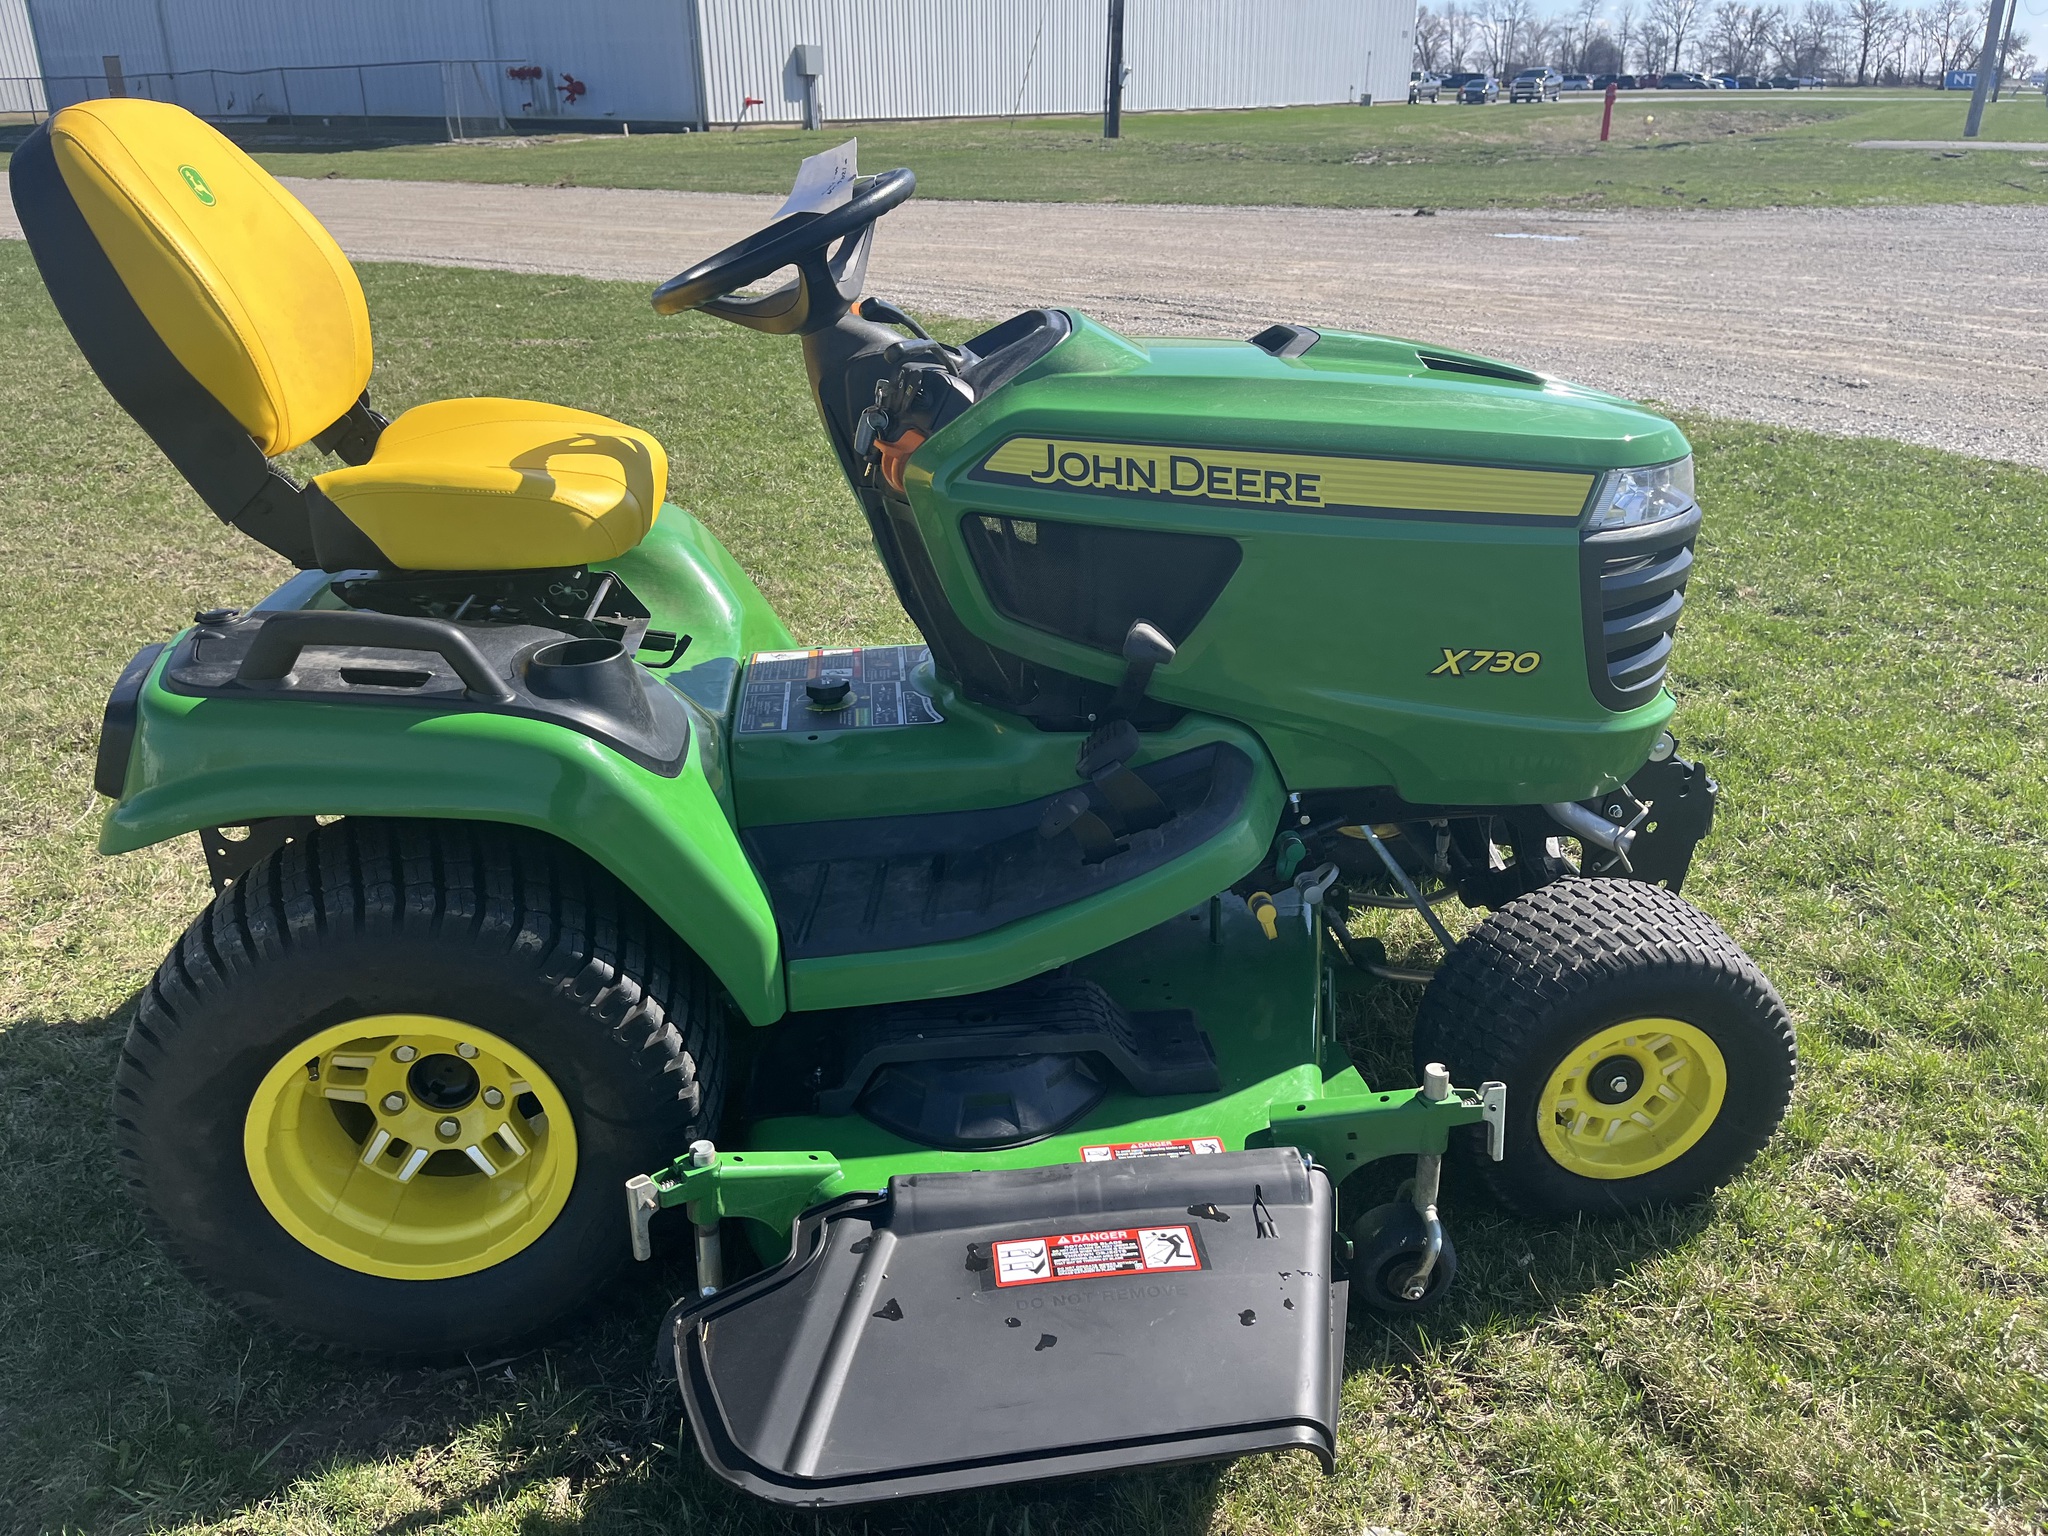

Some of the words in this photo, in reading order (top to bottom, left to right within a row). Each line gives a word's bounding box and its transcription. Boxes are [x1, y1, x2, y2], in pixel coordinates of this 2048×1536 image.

[1031, 443, 1157, 489] JOHN
[1170, 455, 1321, 503] DEERE
[1429, 648, 1541, 675] X730
[1138, 1141, 1172, 1149] DANGER
[1072, 1231, 1127, 1243] DANGER
[1016, 1297, 1043, 1311] DO
[1053, 1291, 1096, 1307] NOT
[1102, 1284, 1188, 1301] REMOVE
